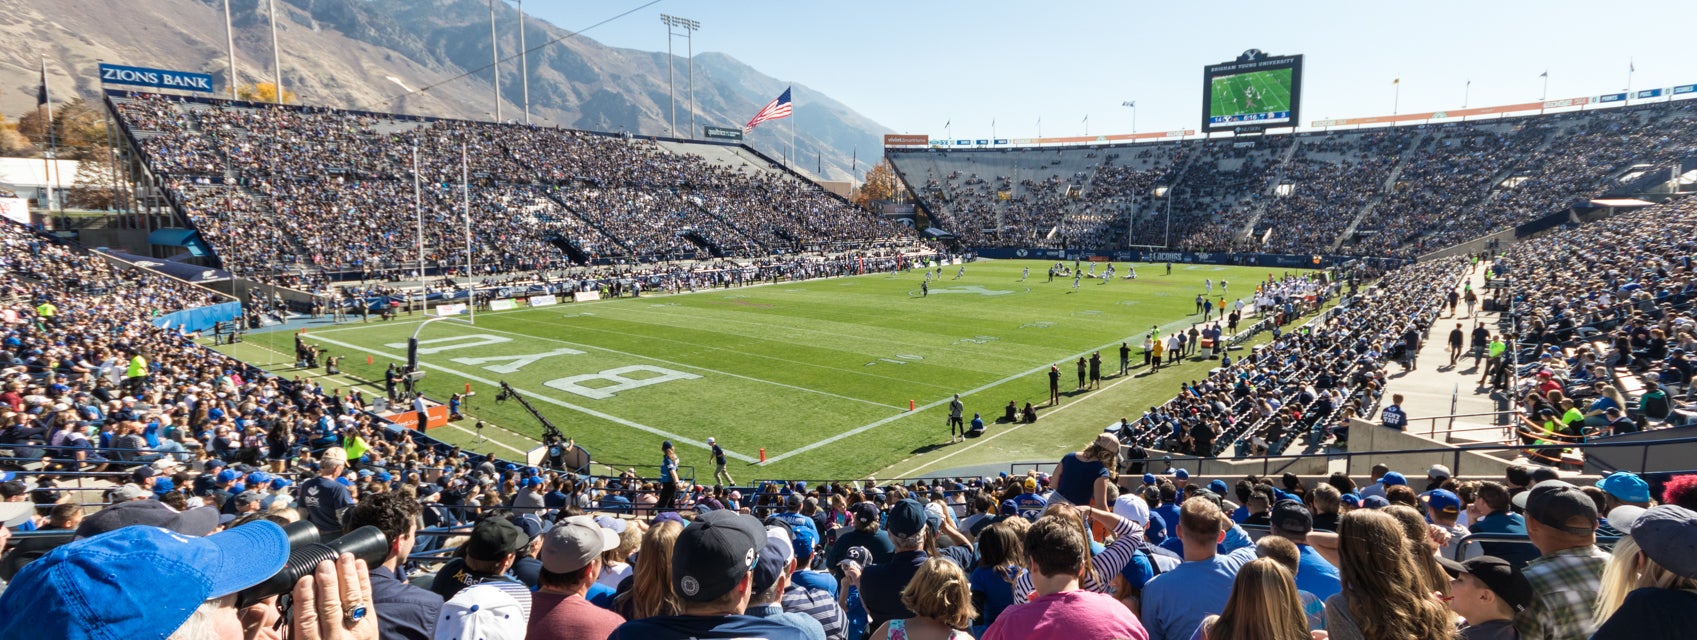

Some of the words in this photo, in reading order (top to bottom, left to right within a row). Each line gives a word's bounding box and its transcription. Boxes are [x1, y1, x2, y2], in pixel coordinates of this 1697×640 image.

[1258, 58, 1295, 67] UNIVERSITY
[102, 67, 159, 84] ZIONS
[162, 73, 210, 90] BANK
